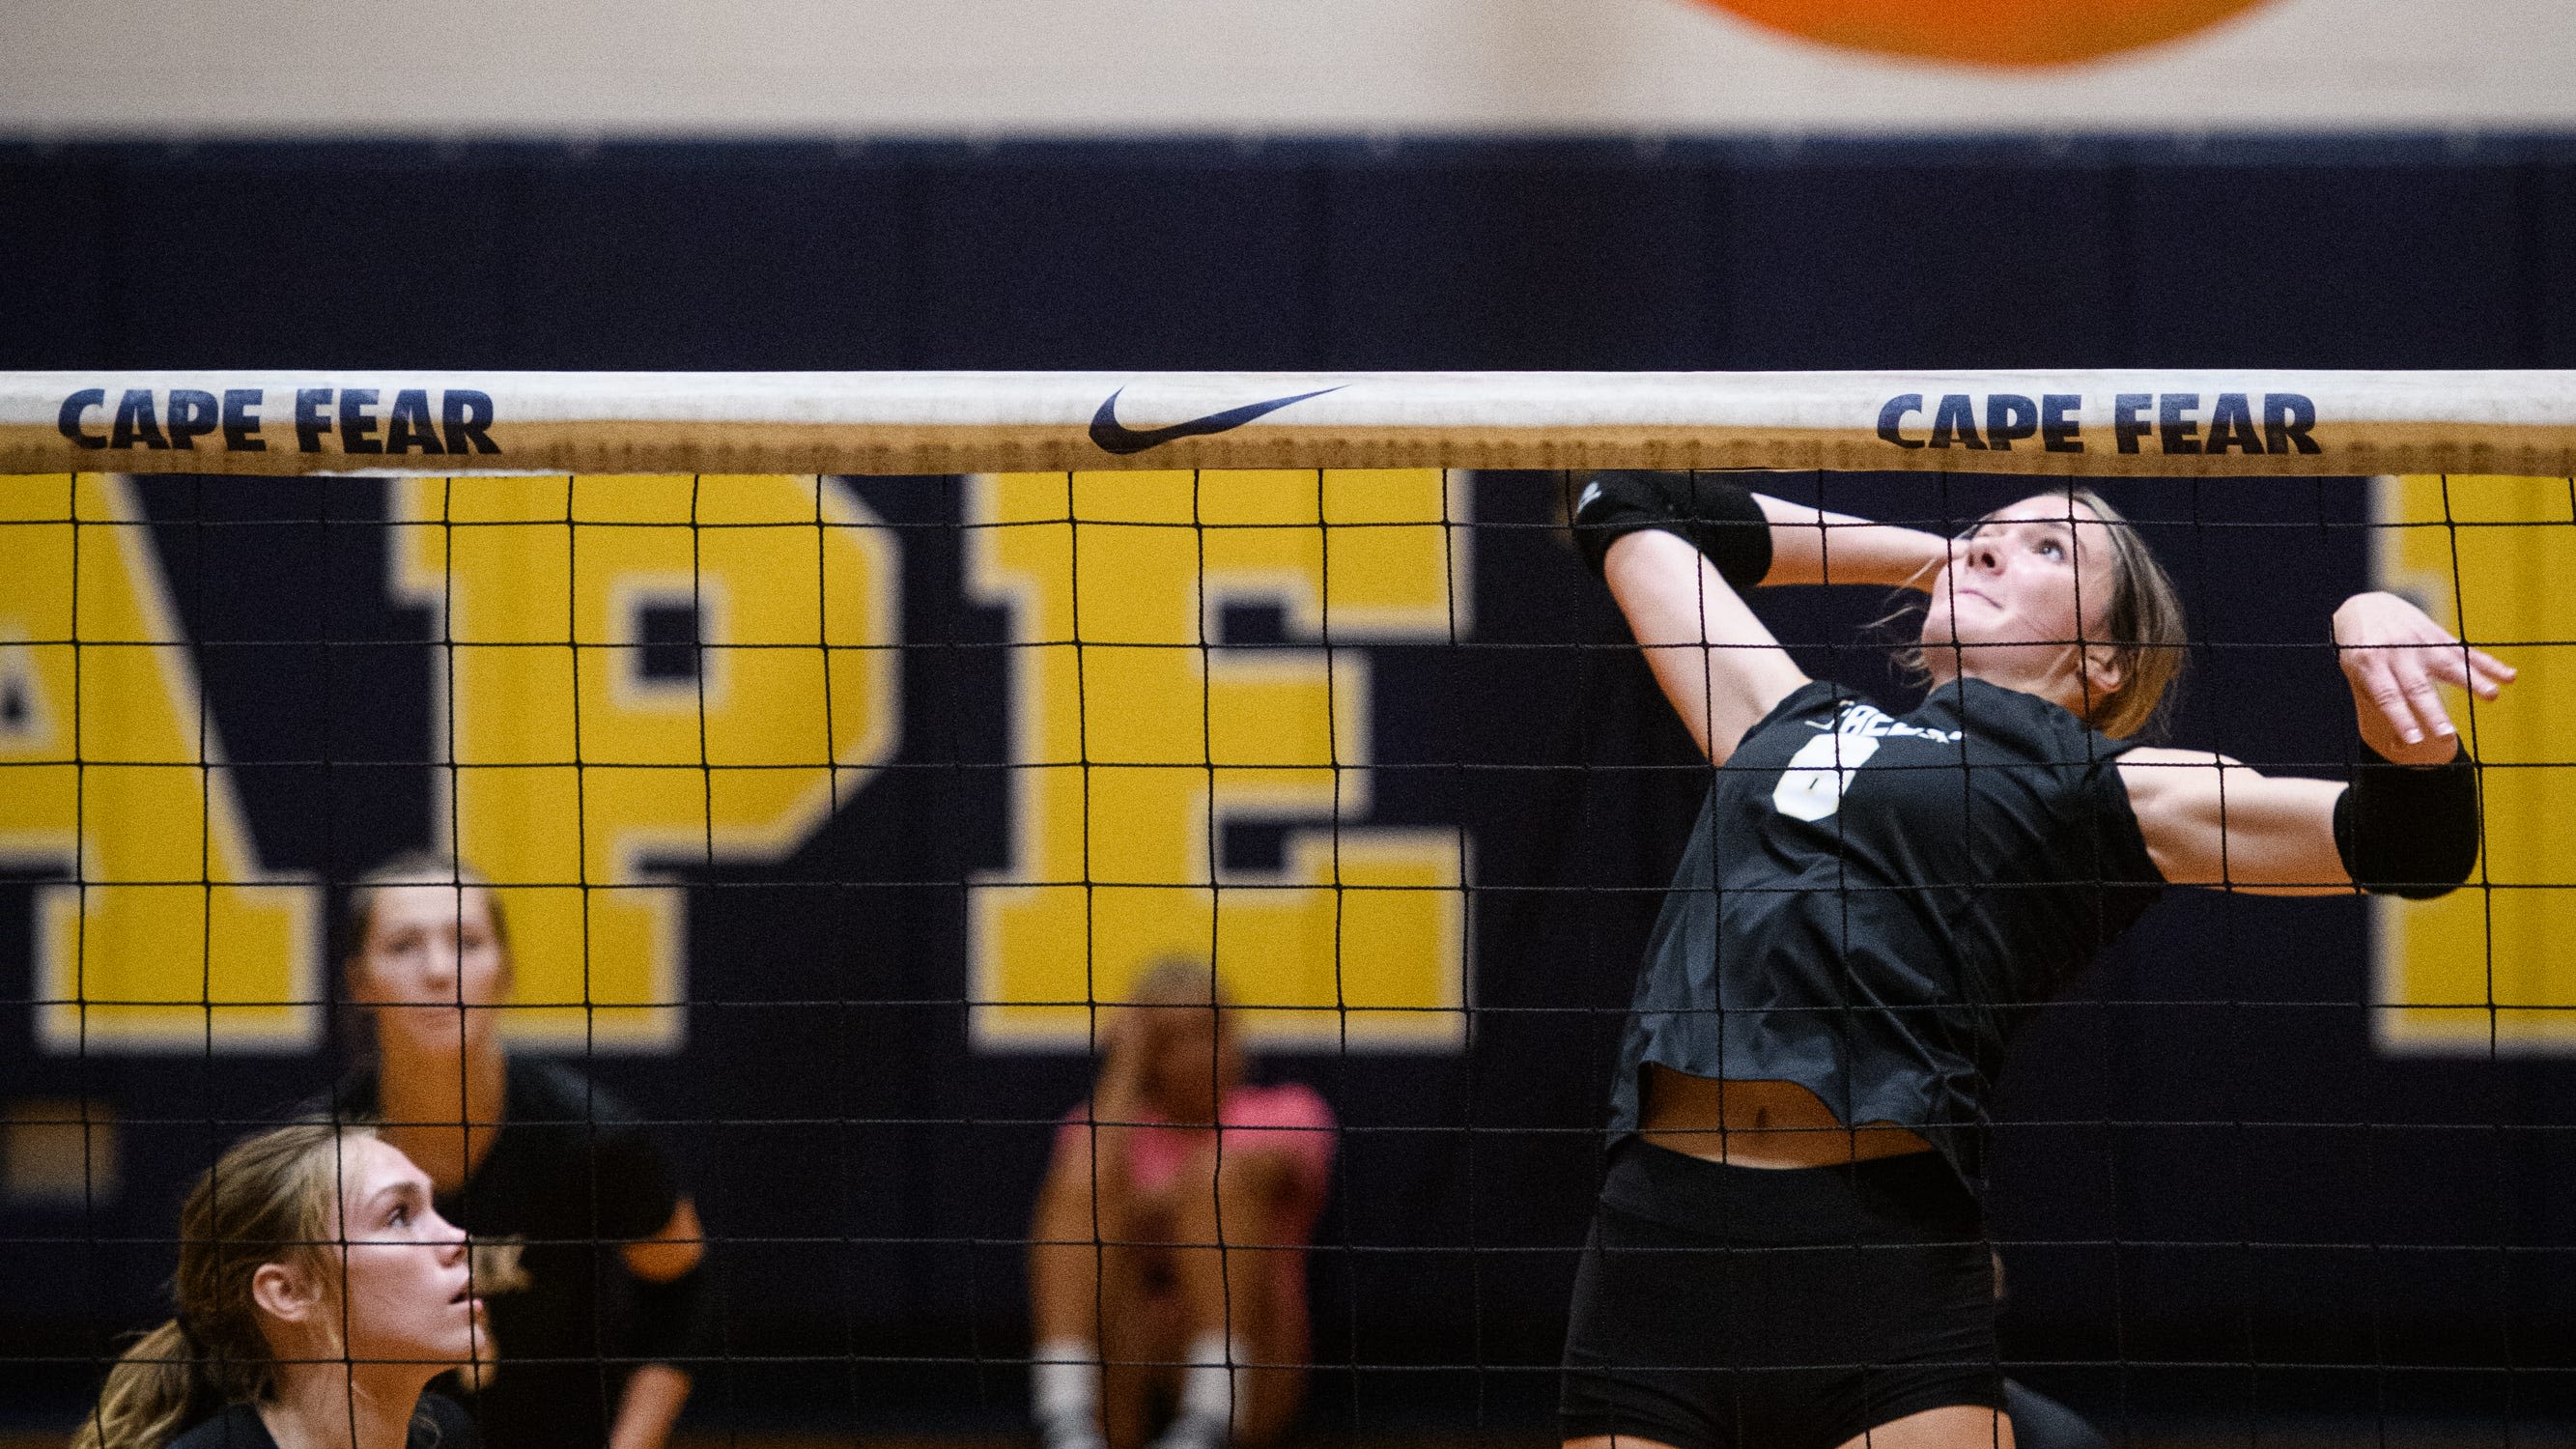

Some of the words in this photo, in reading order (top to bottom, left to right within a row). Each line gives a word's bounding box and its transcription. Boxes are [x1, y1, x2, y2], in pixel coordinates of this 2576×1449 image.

[58, 388, 266, 451] CAPE
[295, 388, 501, 455] FEAR
[1878, 394, 2084, 451] CAPE
[2115, 393, 2321, 454] FEAR
